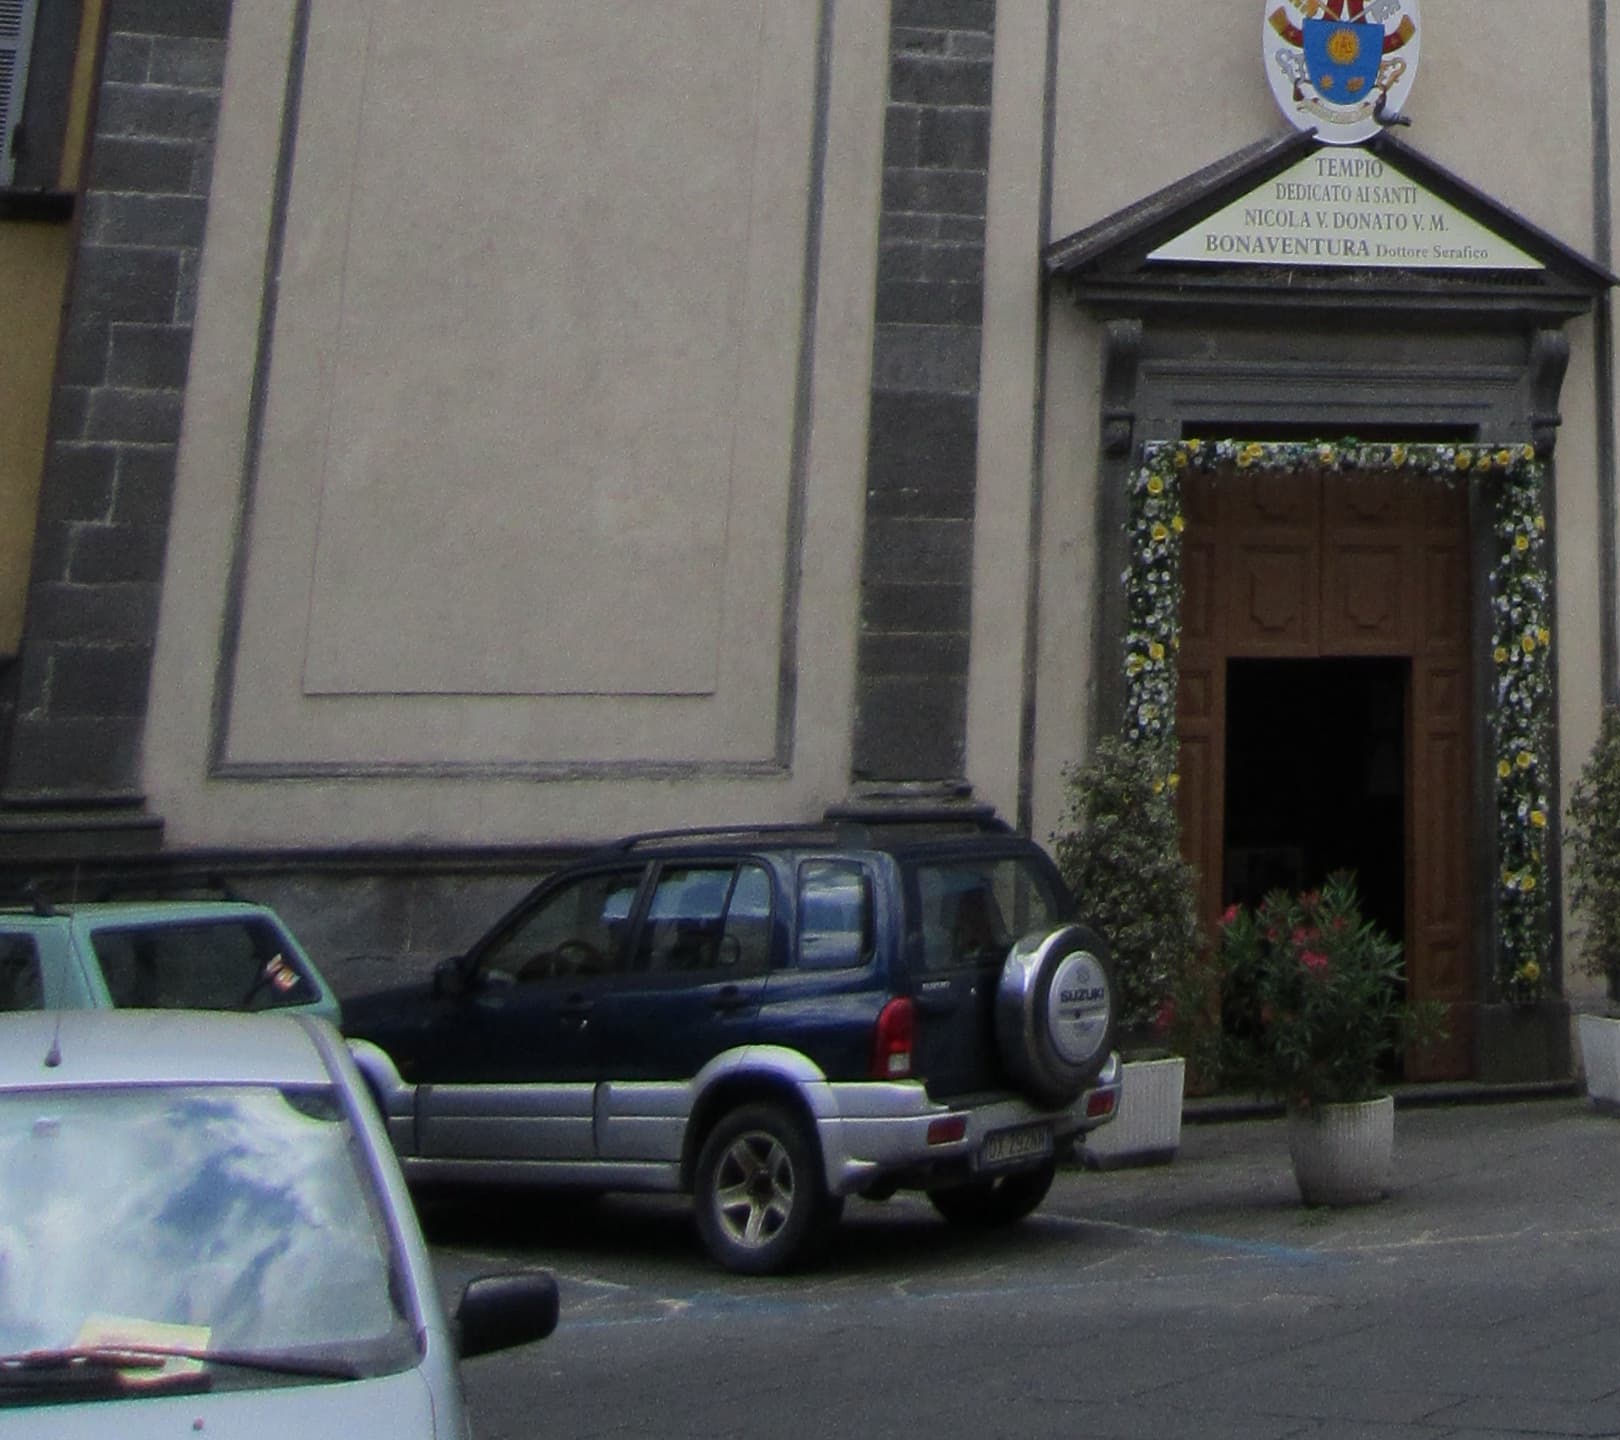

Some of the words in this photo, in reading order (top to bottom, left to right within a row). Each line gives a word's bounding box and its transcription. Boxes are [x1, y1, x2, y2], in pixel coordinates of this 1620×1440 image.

[1315, 157, 1384, 178] TEMPIO
[1276, 183, 1353, 203] DEDICATO
[1356, 187, 1371, 202] AI
[1373, 187, 1417, 204] SANTI
[1244, 209, 1311, 229] NICOLA
[1315, 211, 1328, 229] V.
[1333, 211, 1408, 231] DONATO
[1412, 214, 1426, 231] V.
[1429, 215, 1450, 232] M.
[1205, 234, 1370, 257] BONAVENTURA
[1375, 244, 1429, 259] Dottore
[1432, 244, 1489, 260] Serafico
[1060, 987, 1105, 1003] SUZUKI
